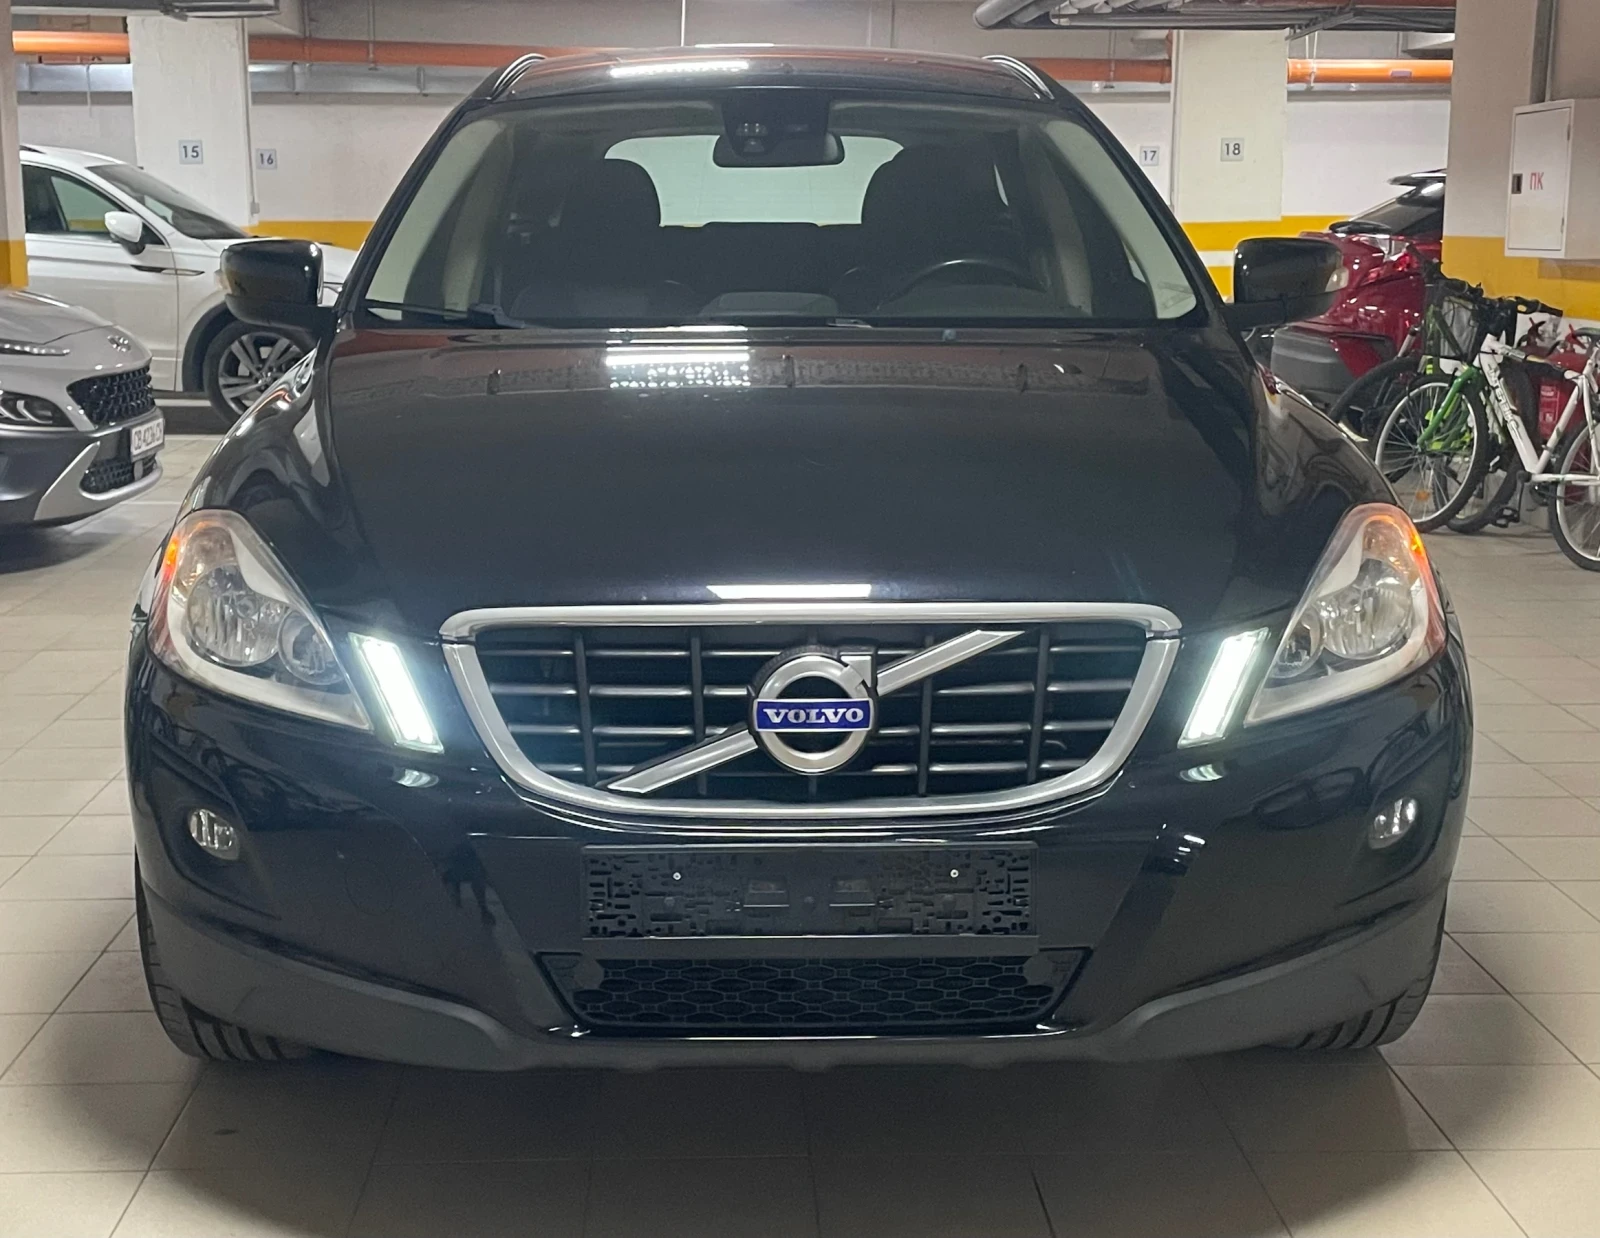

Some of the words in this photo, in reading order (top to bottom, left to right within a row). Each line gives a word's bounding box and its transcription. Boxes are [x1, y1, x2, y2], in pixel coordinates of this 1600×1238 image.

[182, 145, 200, 159] 15
[1143, 150, 1157, 161] 17
[1225, 143, 1241, 156] 18
[259, 153, 274, 165] 16
[1530, 172, 1545, 191] ПК
[763, 708, 864, 723] VOLVO
